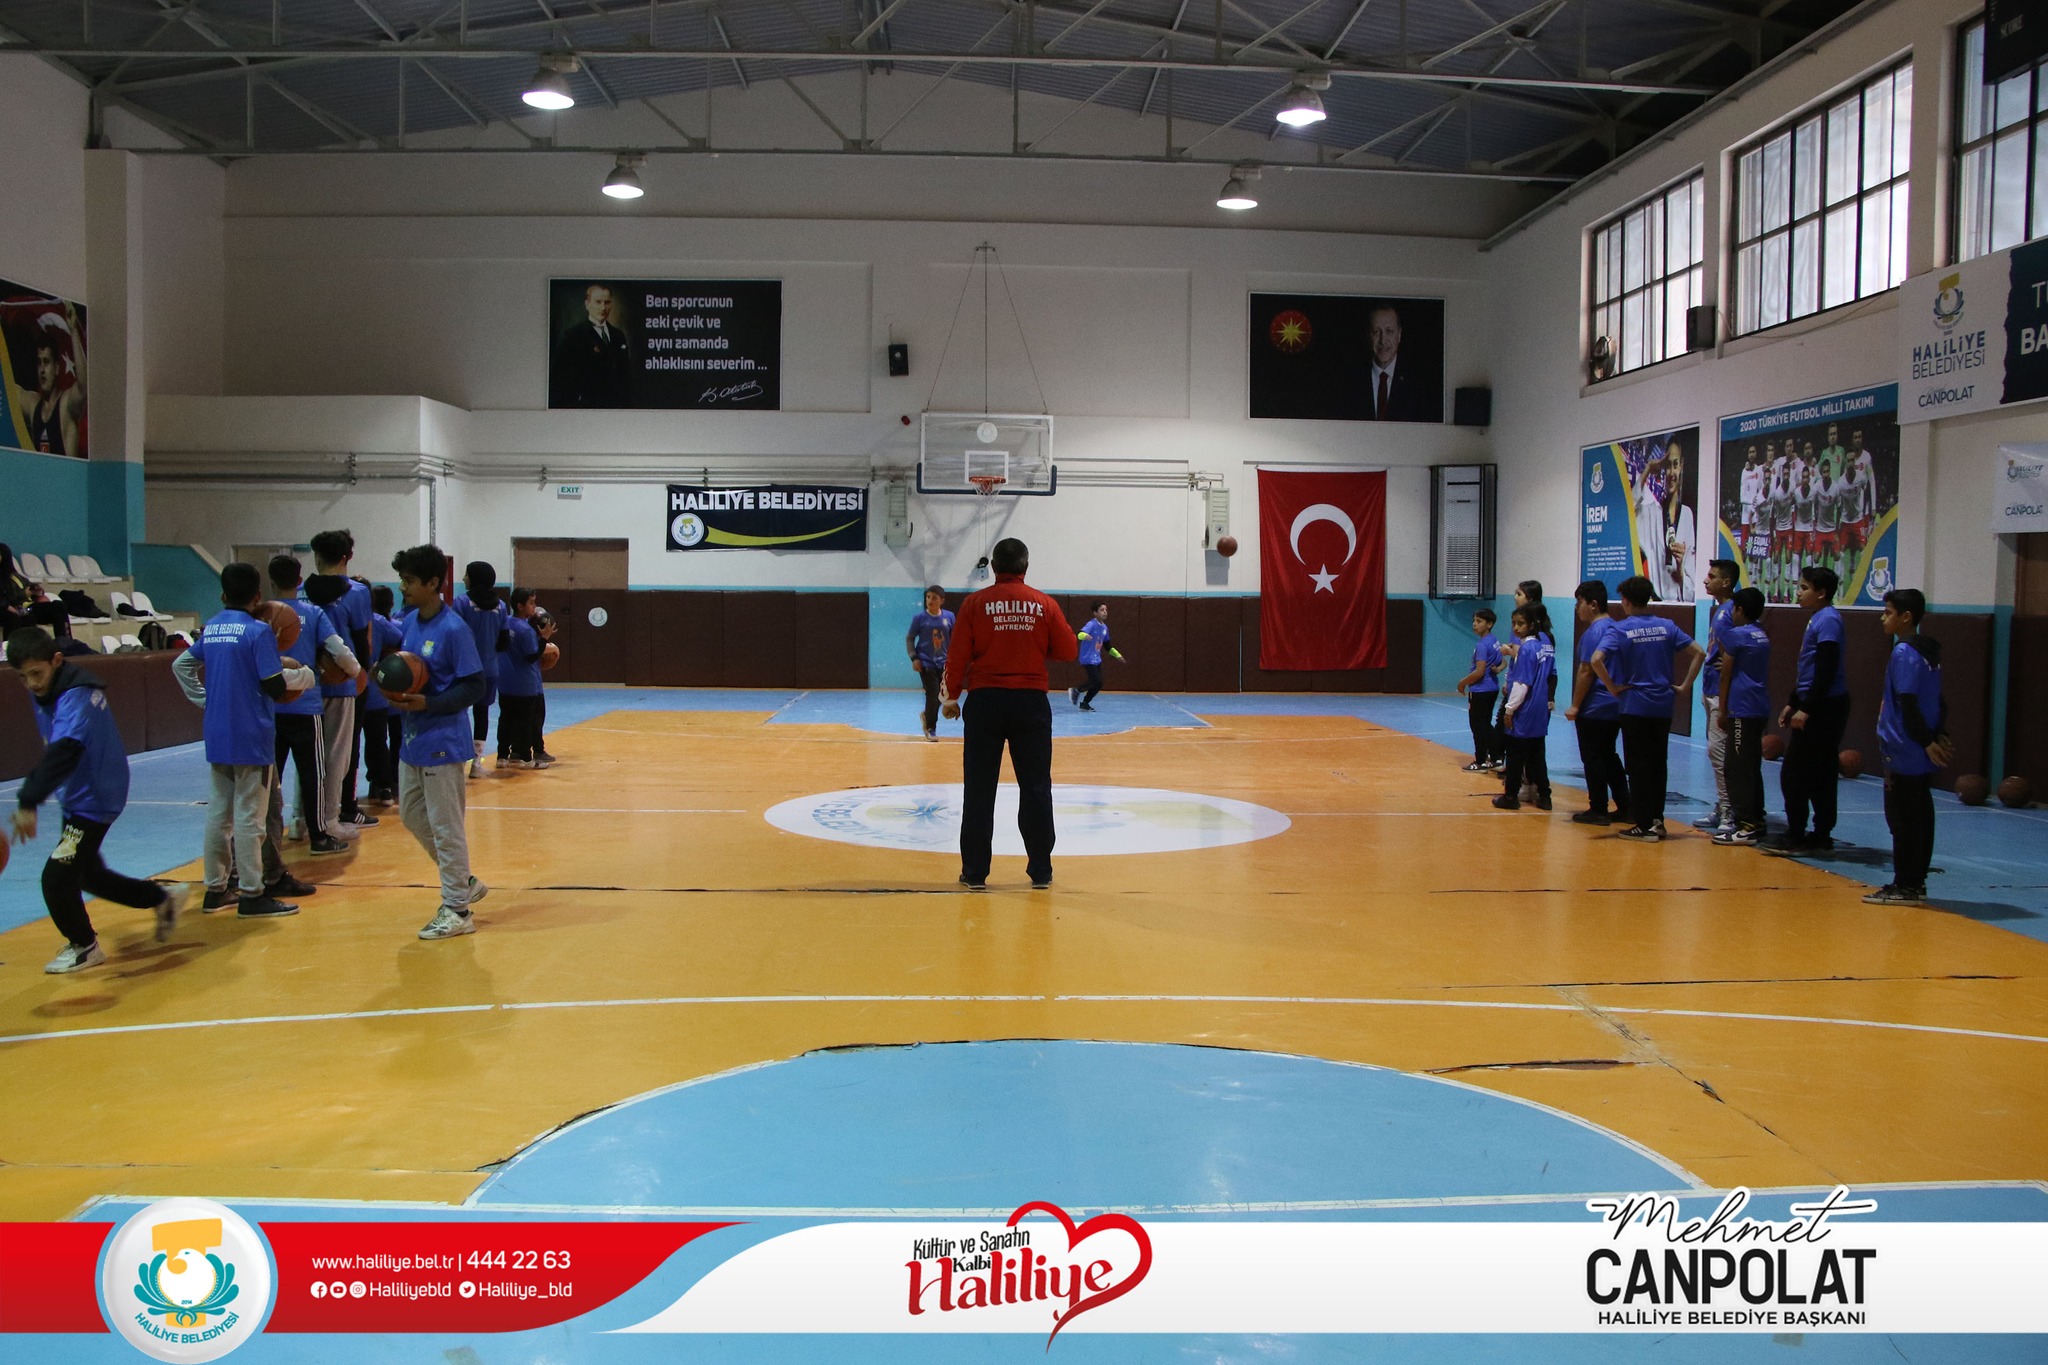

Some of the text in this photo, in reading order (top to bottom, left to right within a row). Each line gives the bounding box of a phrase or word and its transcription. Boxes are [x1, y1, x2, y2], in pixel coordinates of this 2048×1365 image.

[645, 294, 733, 310] Ben sporcunun
[645, 315, 721, 331] zeki çevik ve
[648, 336, 729, 351] aynı zamanda
[645, 356, 704, 370] ahlaklısını
[706, 356, 755, 370] severim
[1912, 349, 1985, 380] BELEDİYESİ
[1918, 385, 1975, 408] CANPOLAT
[1740, 395, 1874, 432] 2020 TÜRKİYE FUTBOL MİLLİ TAKIMI
[758, 489, 863, 511] BELEDİYESİ
[1586, 504, 1608, 523] İREM
